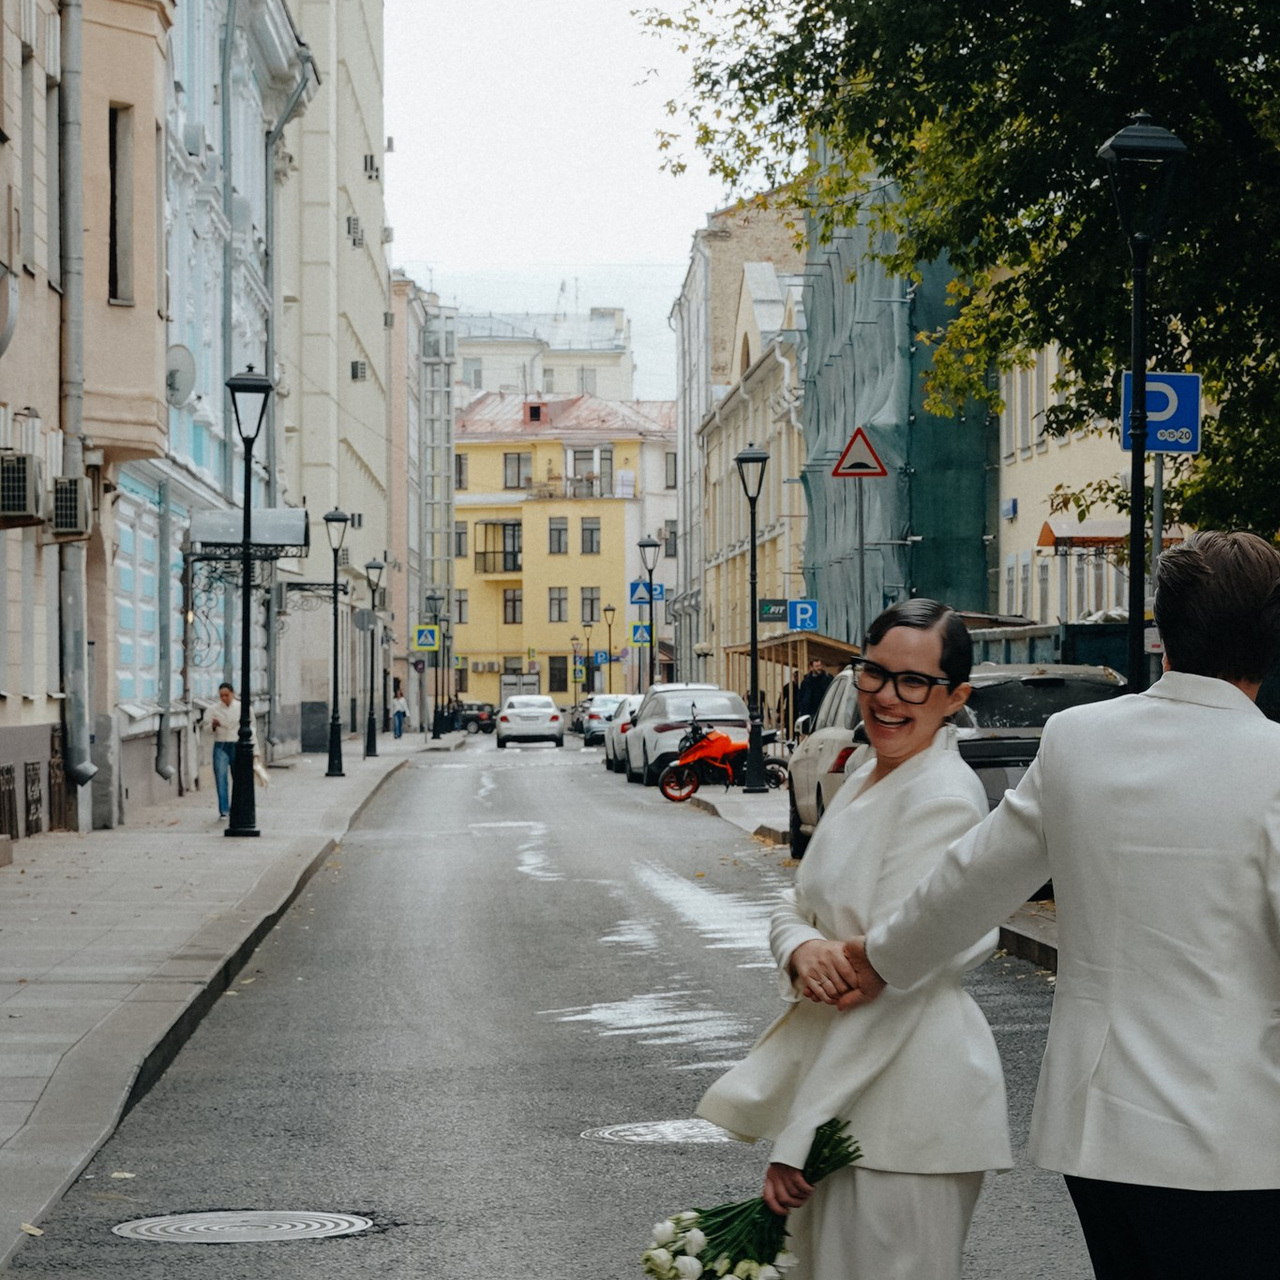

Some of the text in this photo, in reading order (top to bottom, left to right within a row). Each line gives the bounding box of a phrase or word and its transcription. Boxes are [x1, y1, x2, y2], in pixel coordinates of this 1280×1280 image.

[1168, 431, 1176, 439] 15
[1178, 430, 1191, 440] 20
[796, 603, 813, 627] P
